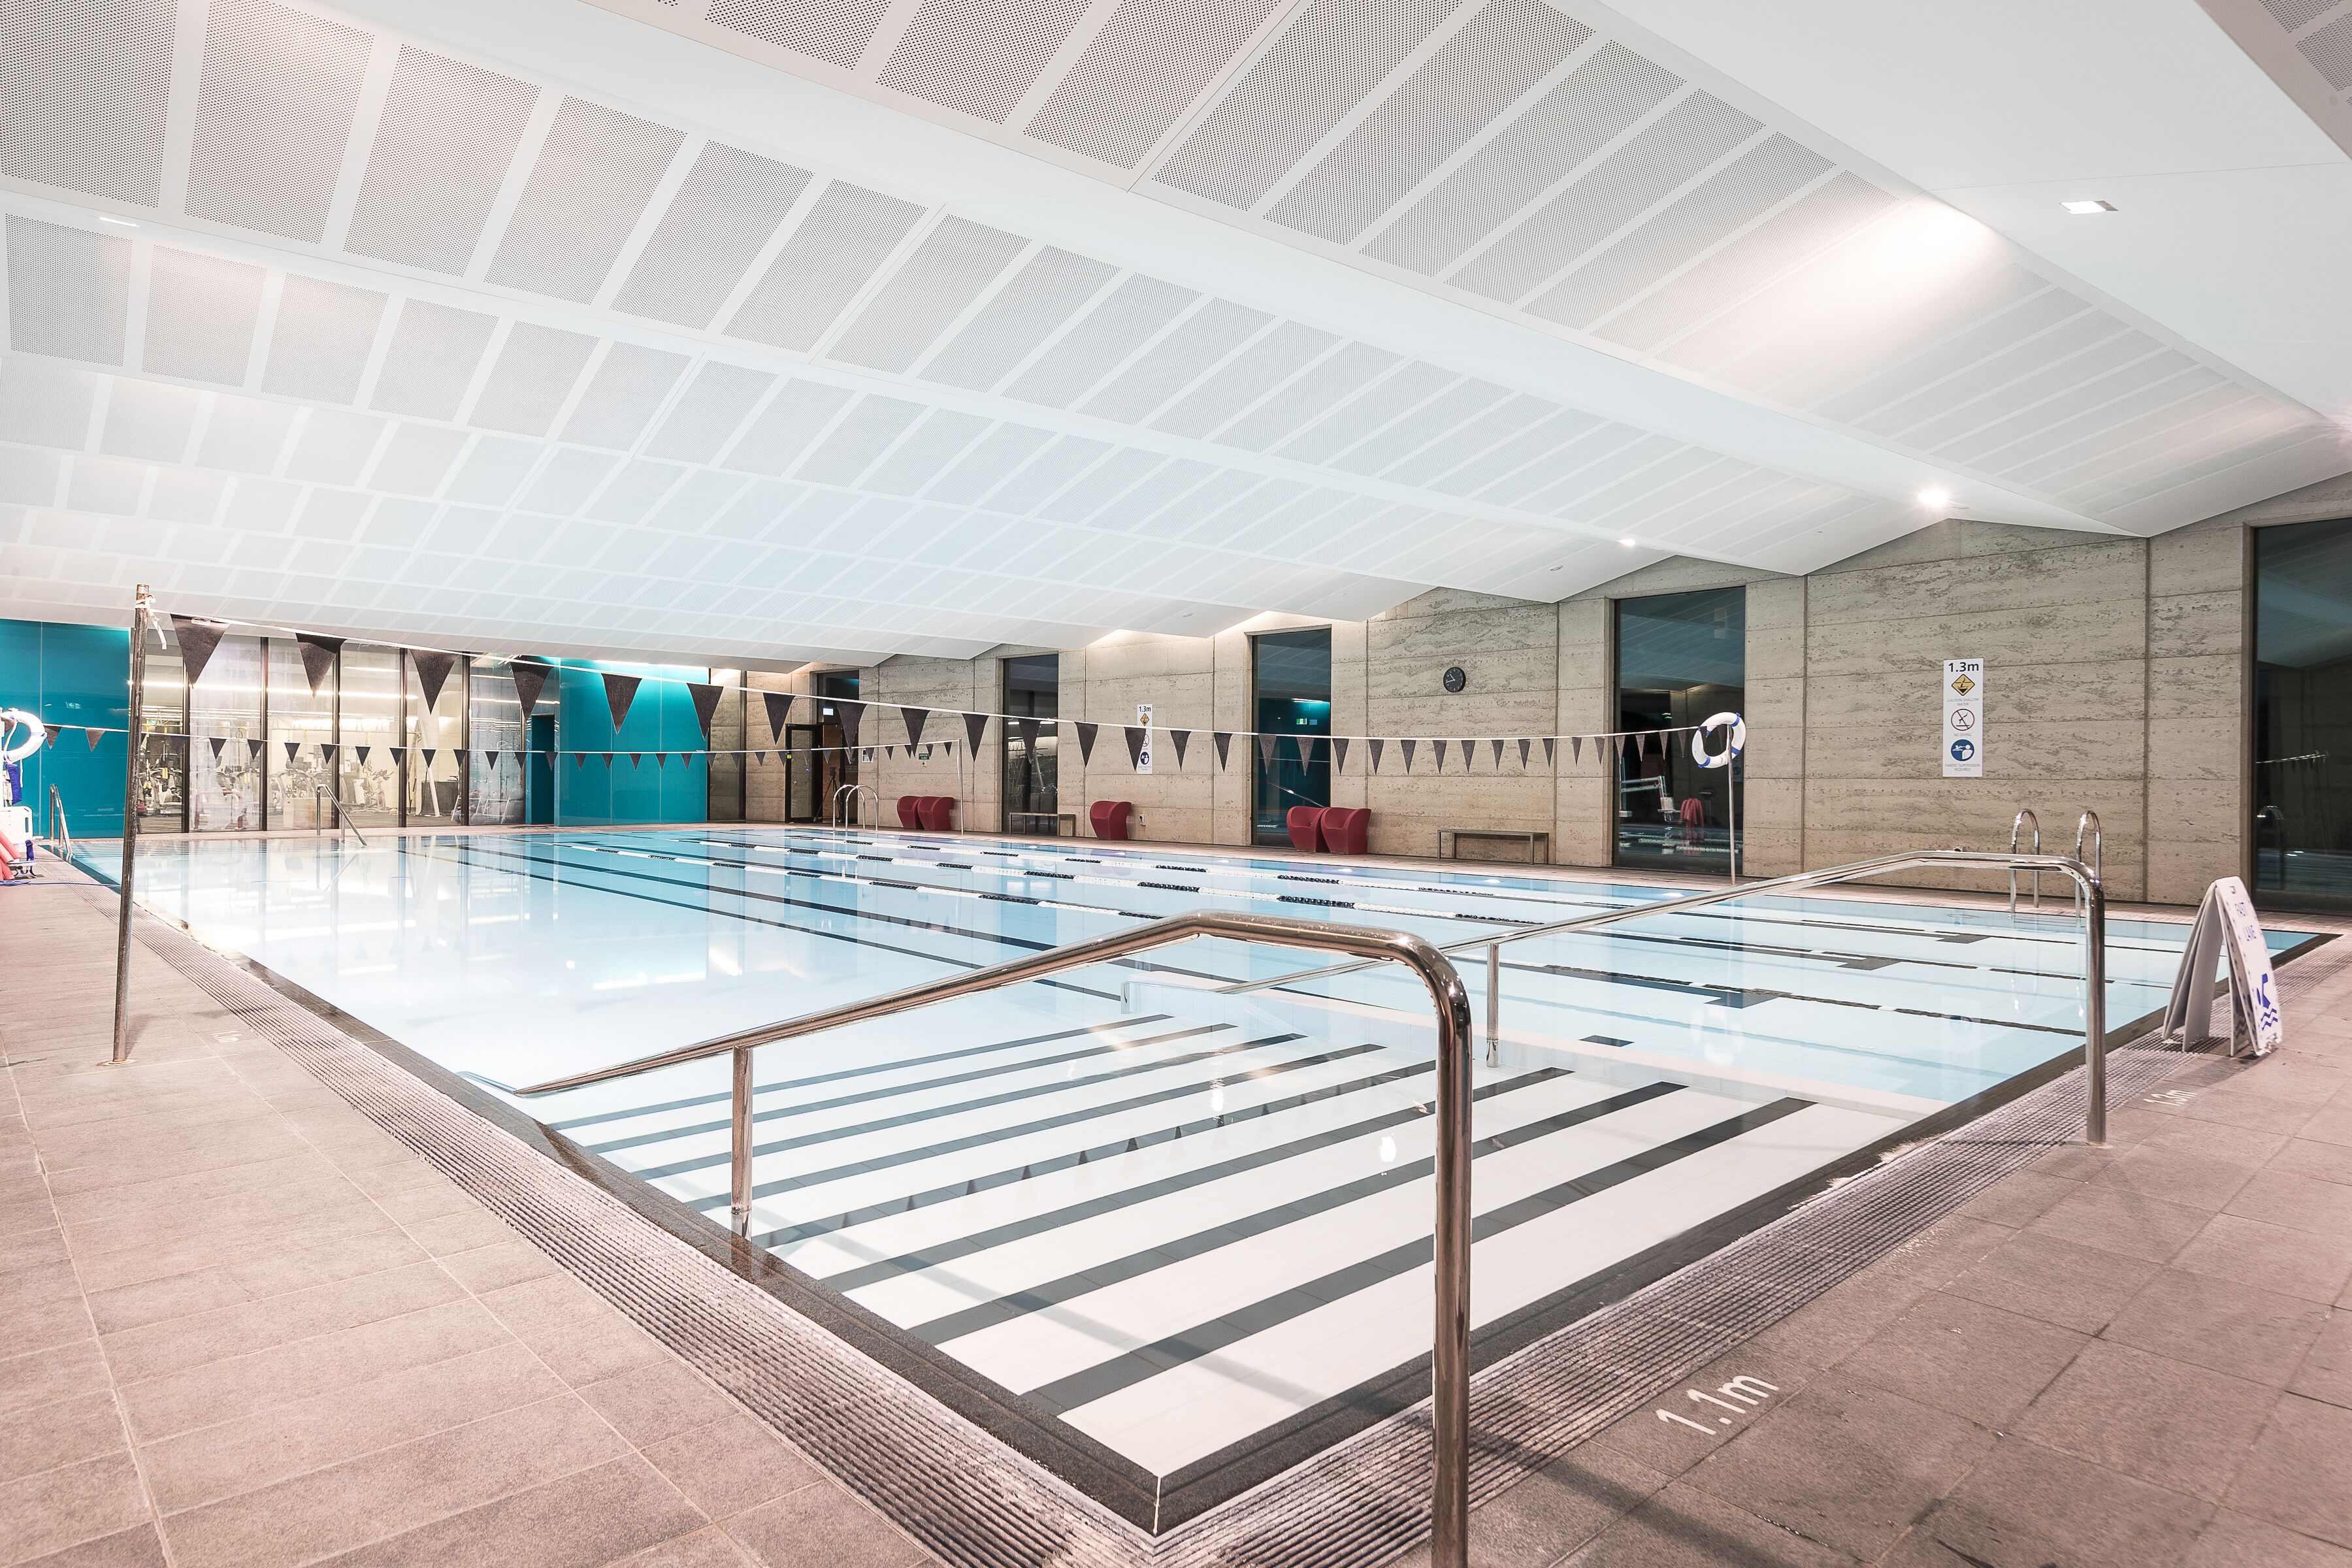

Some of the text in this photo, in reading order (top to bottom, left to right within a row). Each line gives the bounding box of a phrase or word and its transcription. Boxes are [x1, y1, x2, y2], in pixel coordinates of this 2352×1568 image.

[1948, 662, 1980, 672] 1.3m
[2143, 1090, 2198, 1105] 1.3m
[1656, 1375, 1779, 1435] 1.1m
